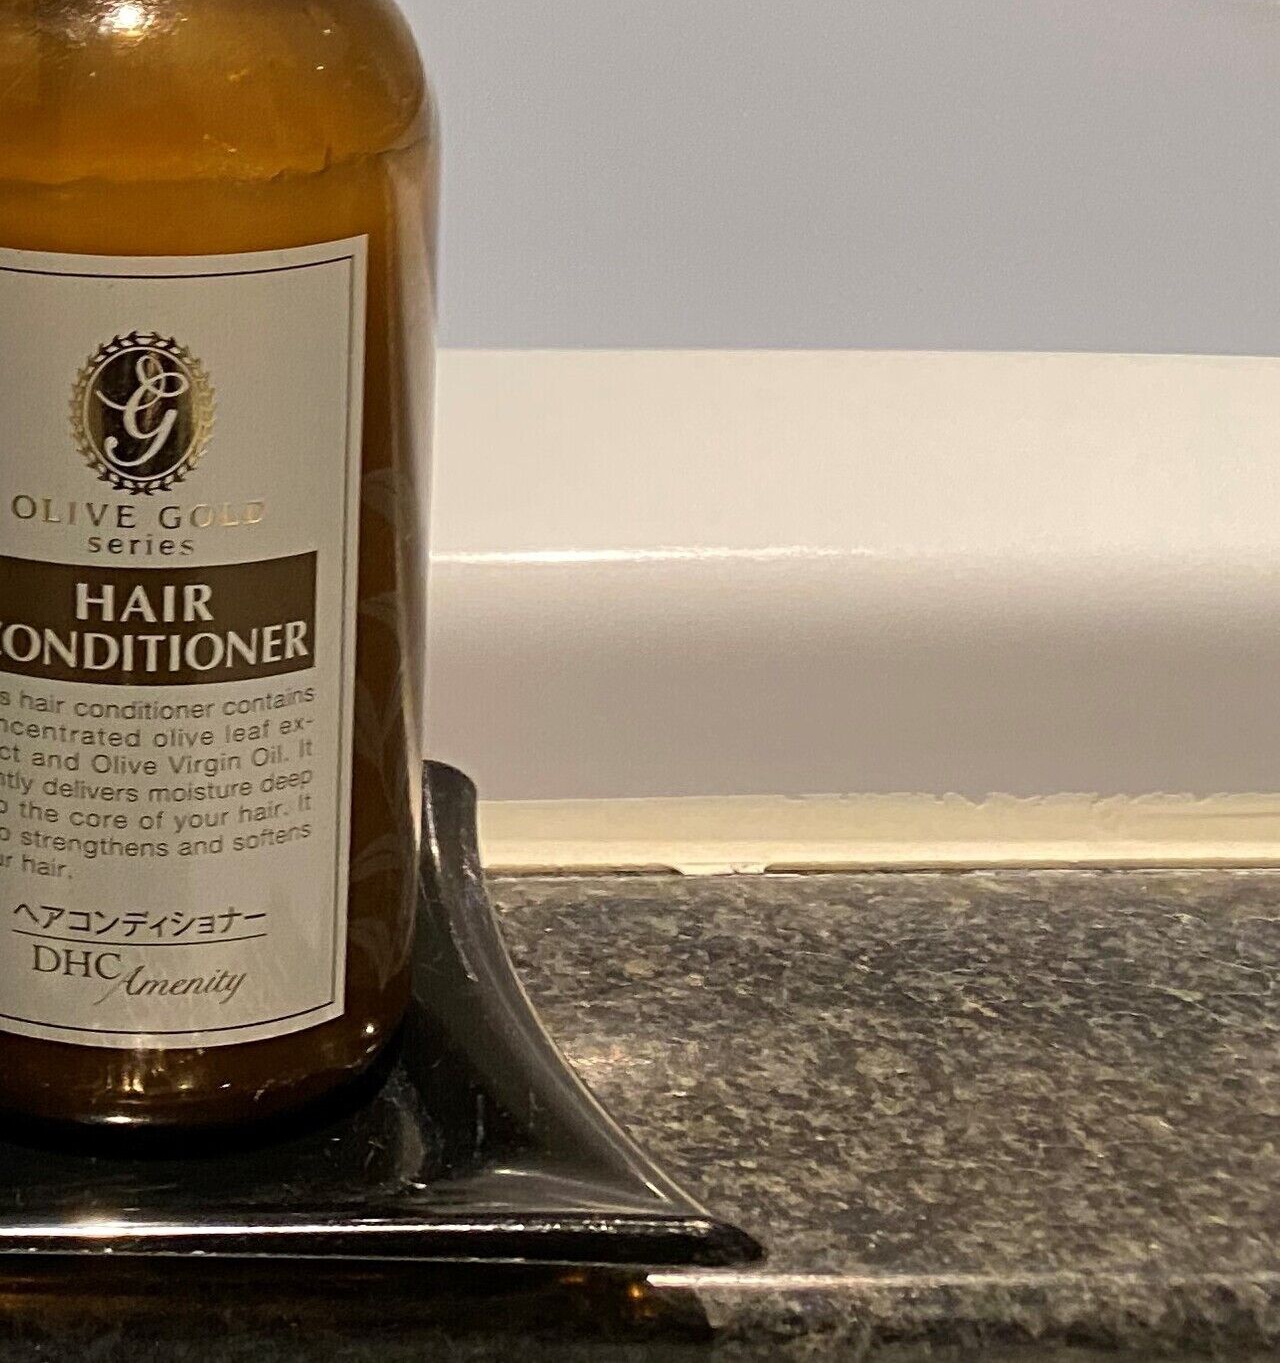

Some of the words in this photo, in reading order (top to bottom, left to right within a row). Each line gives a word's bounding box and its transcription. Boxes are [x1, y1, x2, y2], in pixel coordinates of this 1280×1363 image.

[11, 494, 136, 529] OLIVE
[158, 497, 266, 529] GOLD
[87, 534, 194, 556] series
[75, 582, 214, 624] HAIR
[20, 690, 65, 714] hair
[73, 698, 215, 720] conditioner
[222, 687, 316, 716] contains
[152, 727, 214, 748] olive
[225, 719, 270, 743] leaf
[279, 717, 314, 736] ex-
[31, 750, 80, 772] and
[90, 754, 157, 776] Olive
[168, 753, 240, 778] Virgin
[251, 745, 290, 767] Oil.
[299, 738, 313, 758] It
[42, 778, 138, 803] delivers
[148, 781, 252, 803] moisture
[260, 769, 313, 793] deep
[18, 800, 59, 823] the
[69, 811, 128, 830] core
[139, 810, 164, 829] of
[173, 811, 229, 834] your
[238, 799, 289, 823] hair.
[298, 792, 312, 812] It
[20, 829, 170, 859] strengthens
[177, 835, 223, 856] and
[233, 823, 312, 851] softens
[21, 853, 73, 879] hair.
[13, 903, 267, 936] ヘアコンディショナー
[32, 944, 122, 980] DHC
[93, 965, 247, 1006] Amenity
